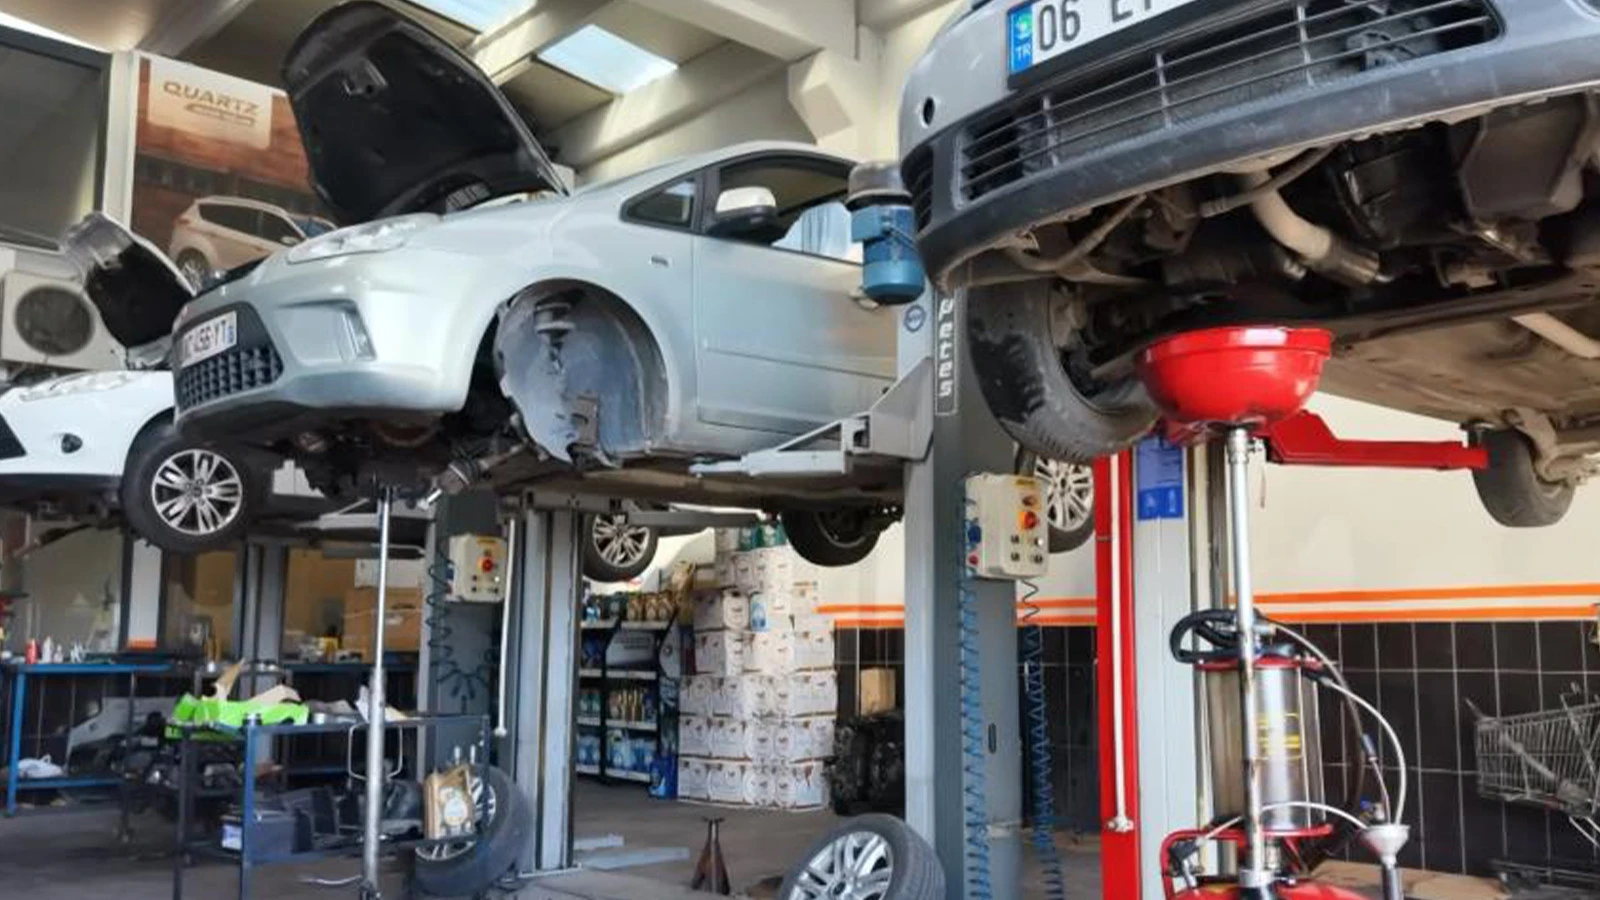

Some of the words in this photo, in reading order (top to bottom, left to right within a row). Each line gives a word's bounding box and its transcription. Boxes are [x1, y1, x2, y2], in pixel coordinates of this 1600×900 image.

[1016, 42, 1031, 61] TR
[1039, 0, 1080, 51] 06
[163, 81, 259, 114] QUARTZ
